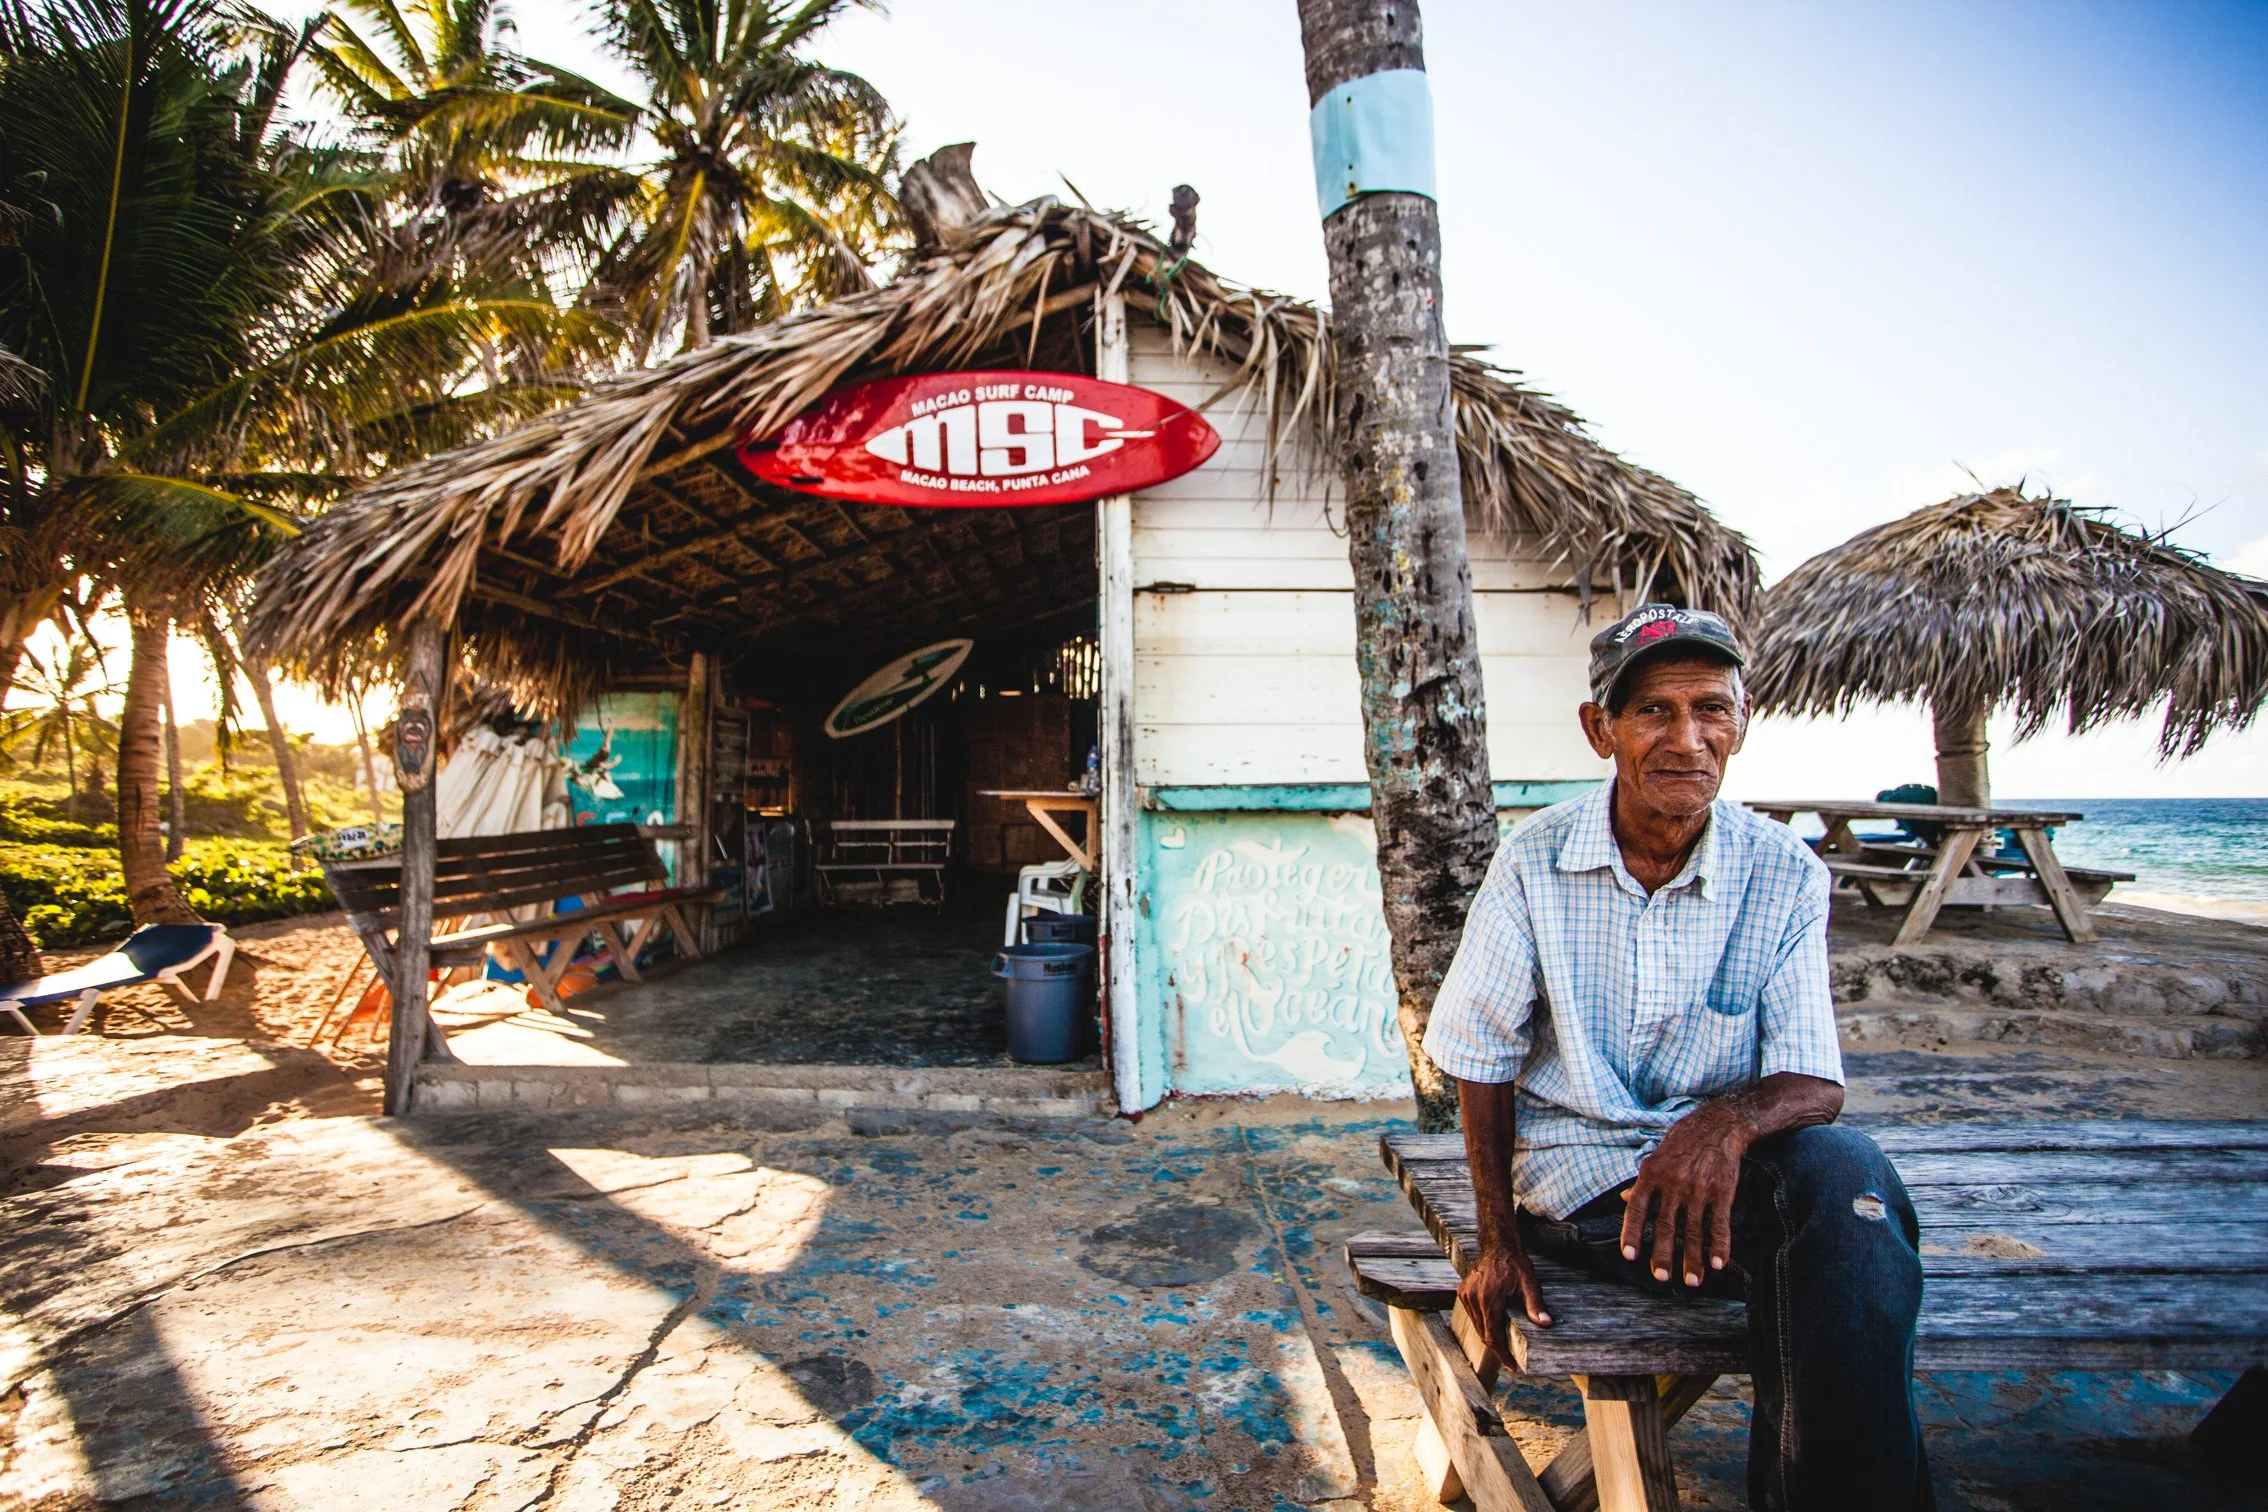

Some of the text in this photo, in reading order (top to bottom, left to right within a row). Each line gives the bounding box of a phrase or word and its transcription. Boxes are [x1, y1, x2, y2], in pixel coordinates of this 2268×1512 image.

[911, 384, 1075, 417] MACAO SURF CAMP
[900, 465, 1091, 494] MACAO BEACH, PUNTA CANA
[1193, 848, 1384, 904] Proteger
[1167, 888, 1391, 951] Disfruta
[1208, 935, 1399, 1005] Respeta
